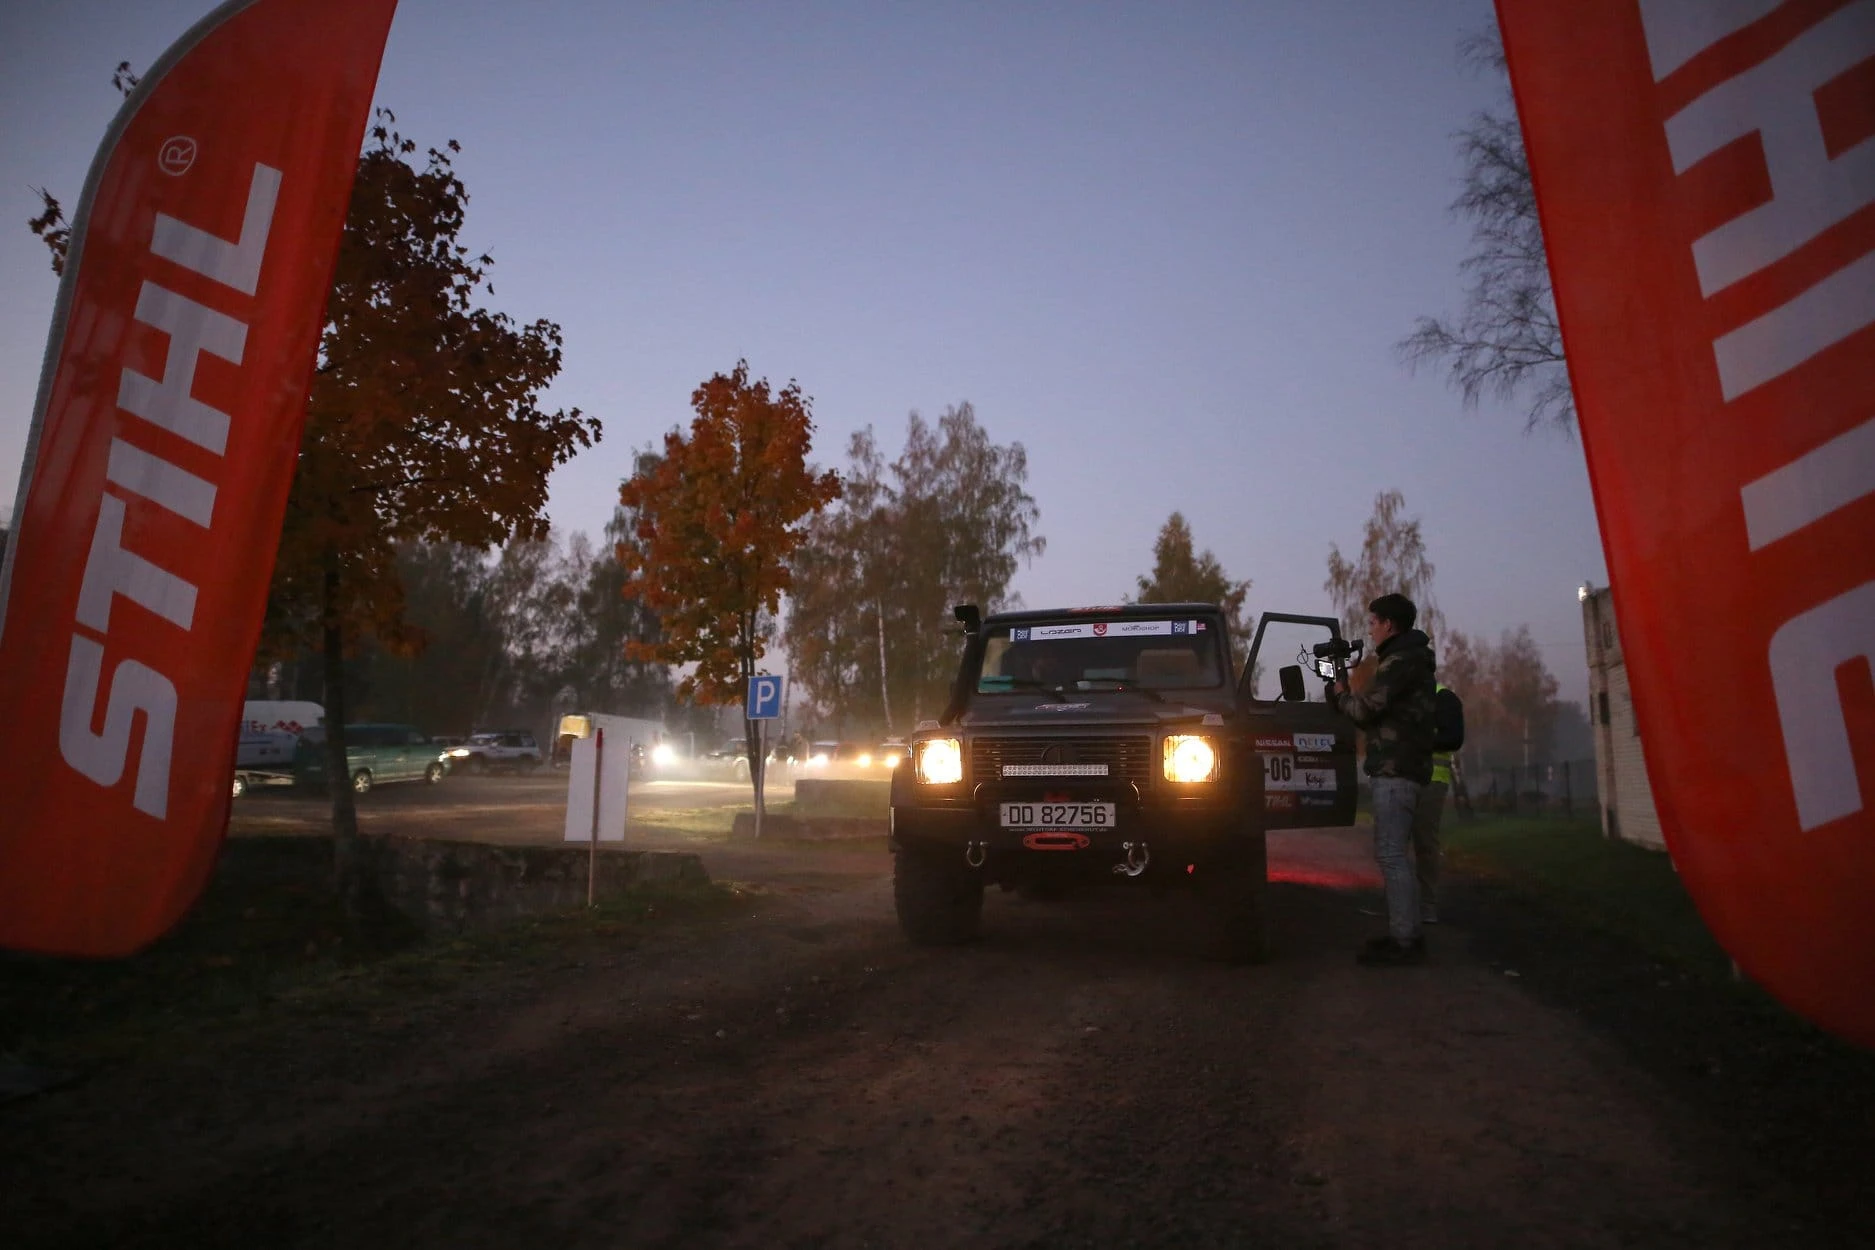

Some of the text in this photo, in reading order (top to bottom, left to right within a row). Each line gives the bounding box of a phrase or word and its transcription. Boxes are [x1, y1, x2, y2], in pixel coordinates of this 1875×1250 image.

[59, 161, 283, 820] STIHL
[756, 681, 775, 714] P
[1009, 806, 1106, 824] DD 82756
